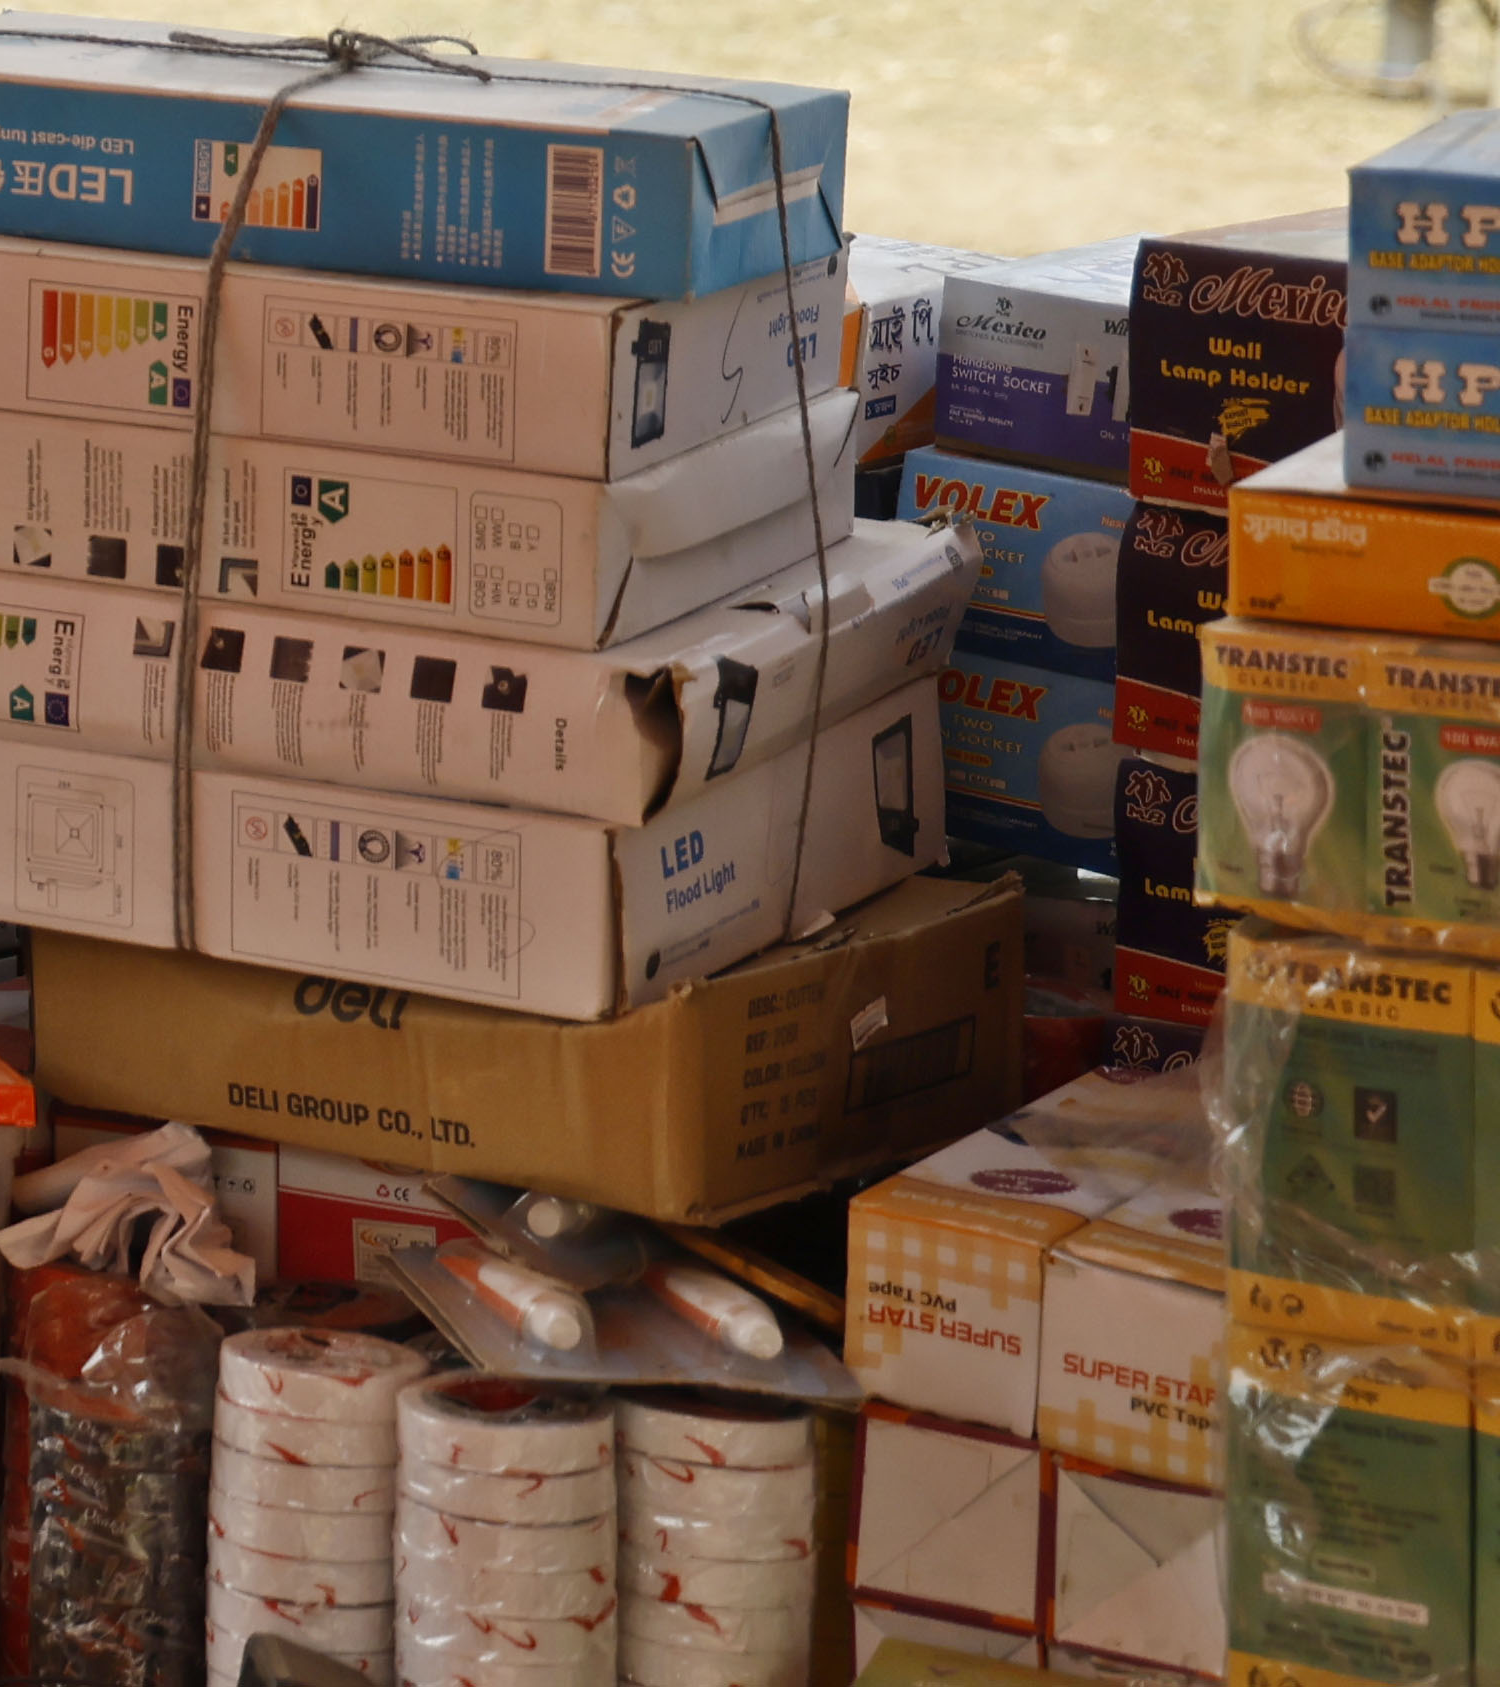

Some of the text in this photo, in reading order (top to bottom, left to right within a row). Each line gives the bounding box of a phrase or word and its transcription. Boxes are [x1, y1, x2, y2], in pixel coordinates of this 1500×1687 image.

[33, 131, 97, 152] die-cast
[100, 138, 135, 156] LED
[172, 304, 195, 375] Energy
[868, 296, 936, 354] আই পি
[956, 314, 1048, 343] Mexico
[952, 354, 1013, 375] Handsome
[1208, 336, 1262, 361] Wall
[868, 362, 902, 393] সুইচ
[952, 366, 1052, 397] SWITCH SOCKET
[1160, 359, 1311, 396] Lamp Holder
[1404, 409, 1471, 431] ADAPTOR
[916, 474, 1050, 532] VOLEX
[1216, 645, 1348, 680] TRANSTEC
[938, 668, 1049, 723] OLEX
[1382, 729, 1412, 907] TRANSTEC
[661, 829, 705, 880] LED
[665, 859, 737, 915] Flood Light
[293, 973, 413, 1031] deli
[228, 1082, 477, 1150] DELI GROUP CO., LTD.
[868, 1280, 958, 1313] PVC Tape
[868, 1303, 1022, 1357] SUPER STAR
